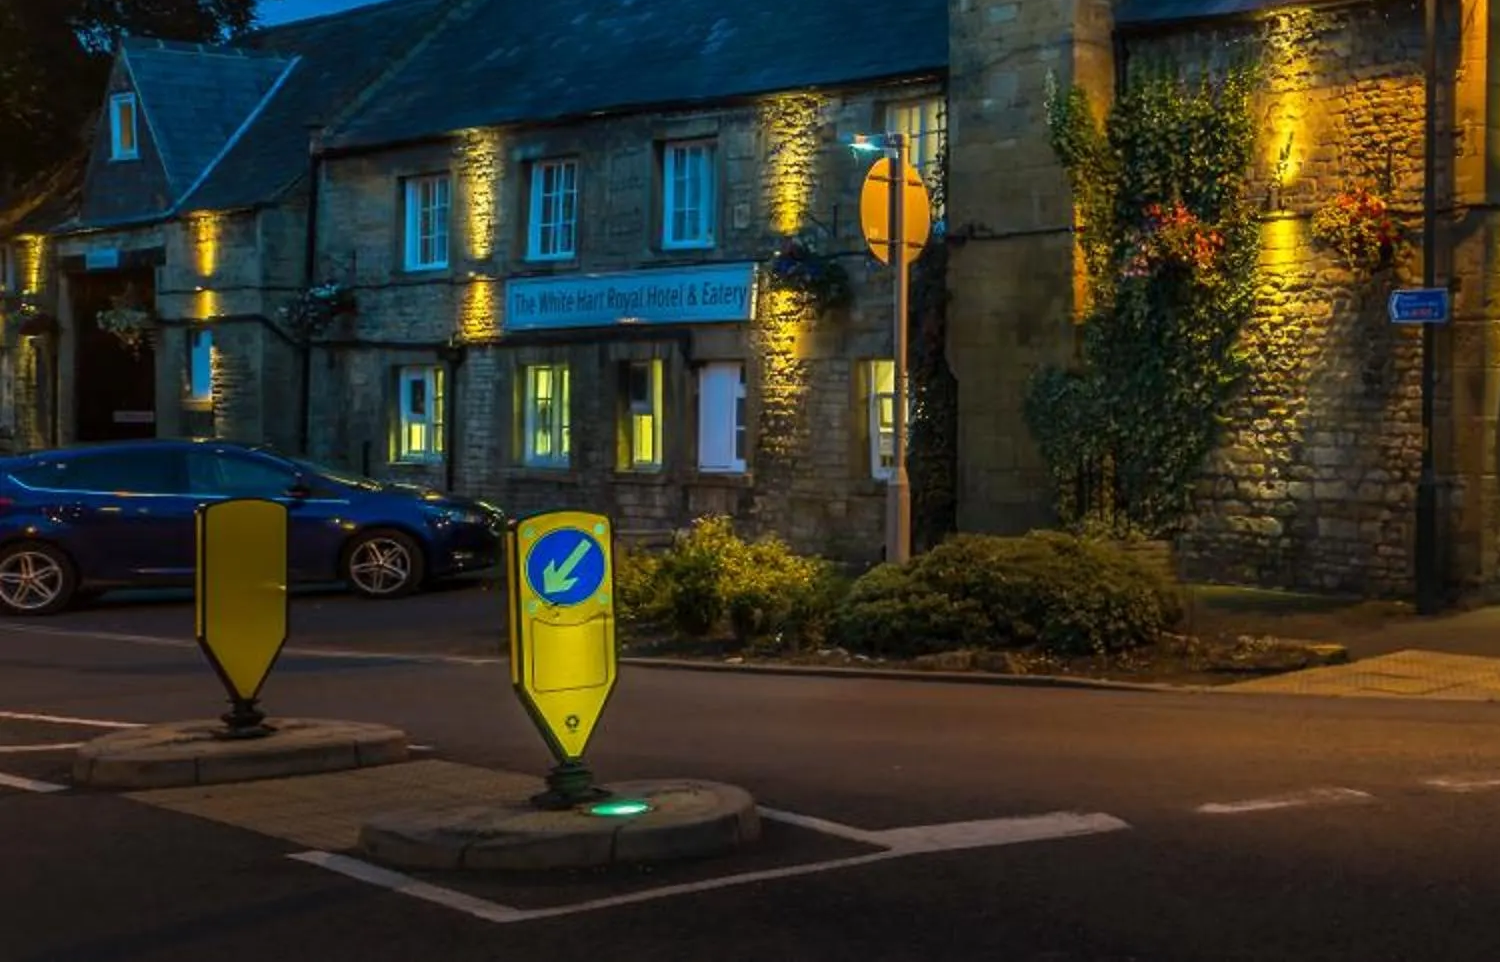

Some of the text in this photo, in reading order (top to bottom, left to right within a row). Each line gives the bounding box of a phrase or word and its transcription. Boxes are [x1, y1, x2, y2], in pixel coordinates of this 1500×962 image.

[515, 294, 537, 316] The
[539, 291, 575, 314] White
[606, 287, 644, 312] Royal
[648, 285, 684, 308] Hotel
[687, 283, 698, 306] &
[702, 281, 747, 306] Eatery
